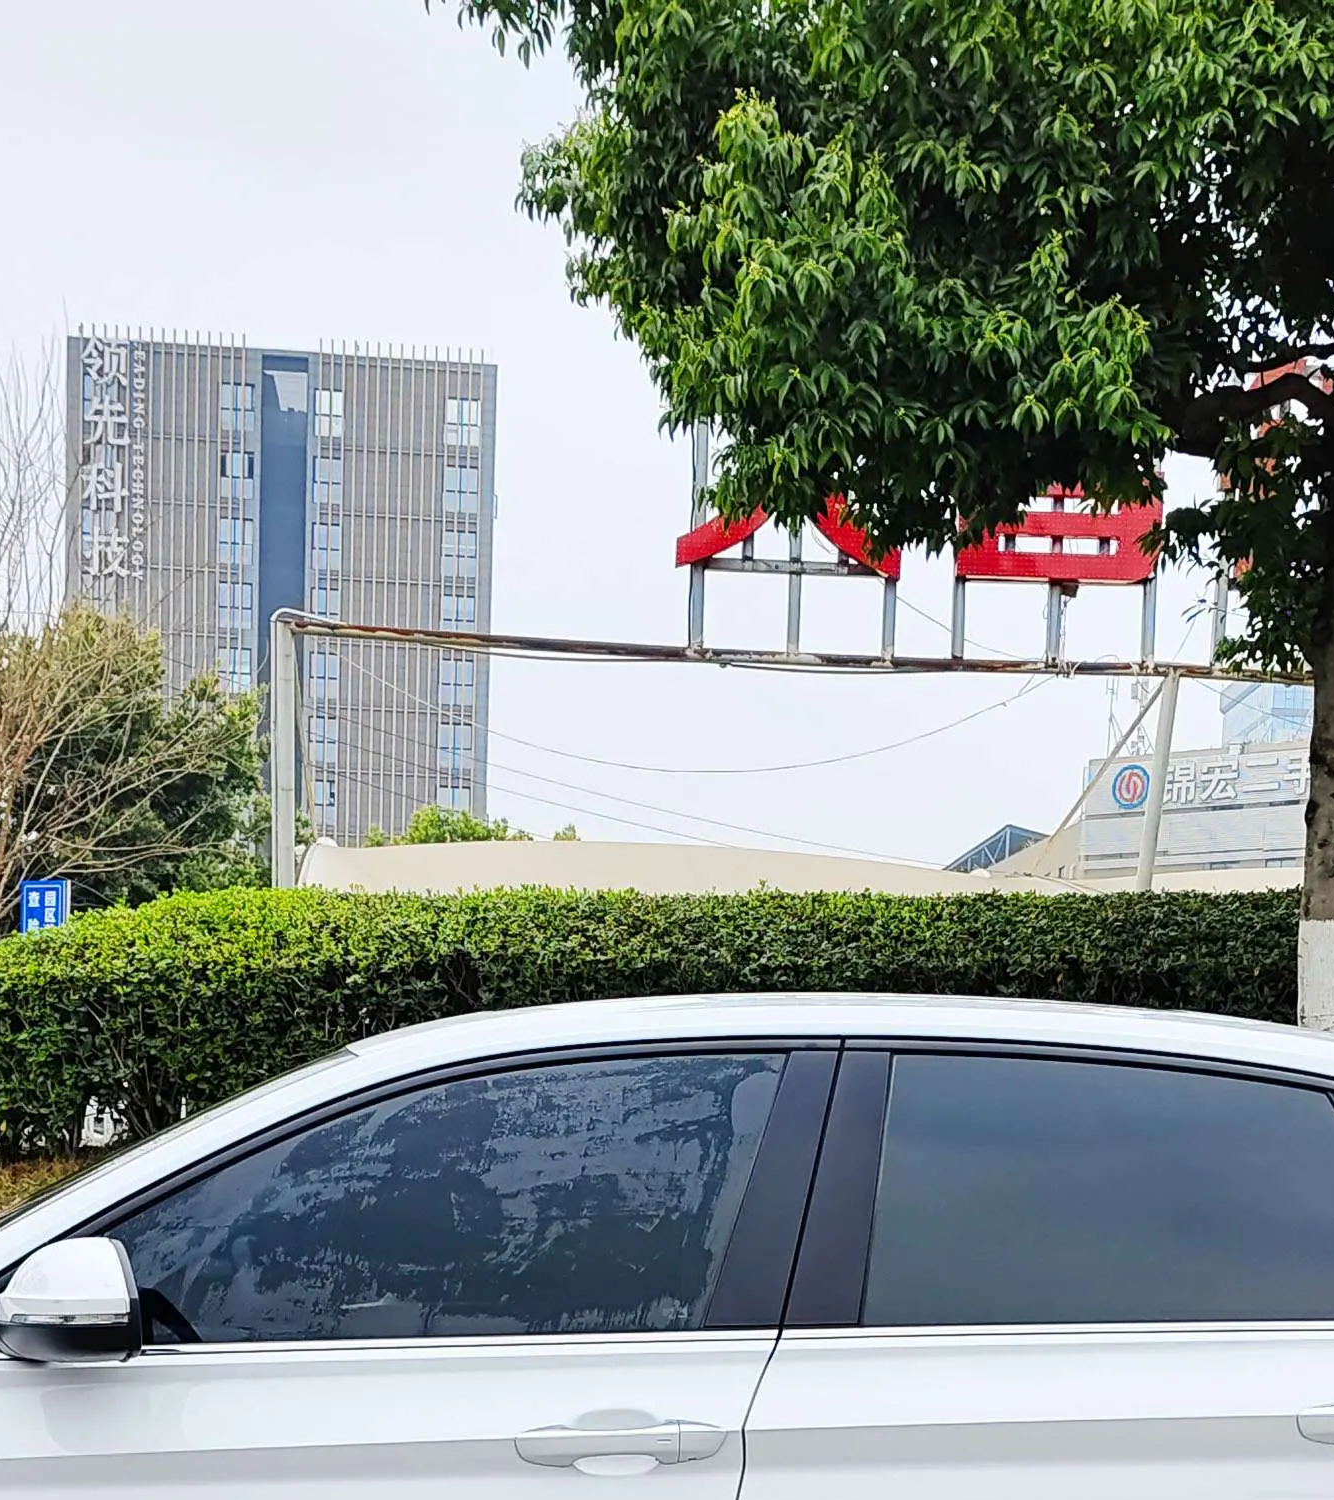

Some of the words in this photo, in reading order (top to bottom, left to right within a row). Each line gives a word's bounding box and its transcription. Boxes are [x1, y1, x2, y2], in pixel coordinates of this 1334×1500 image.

[132, 341, 146, 429] EADING
[80, 336, 130, 577] 领先科技
[131, 442, 145, 580] TECHNOLOGY
